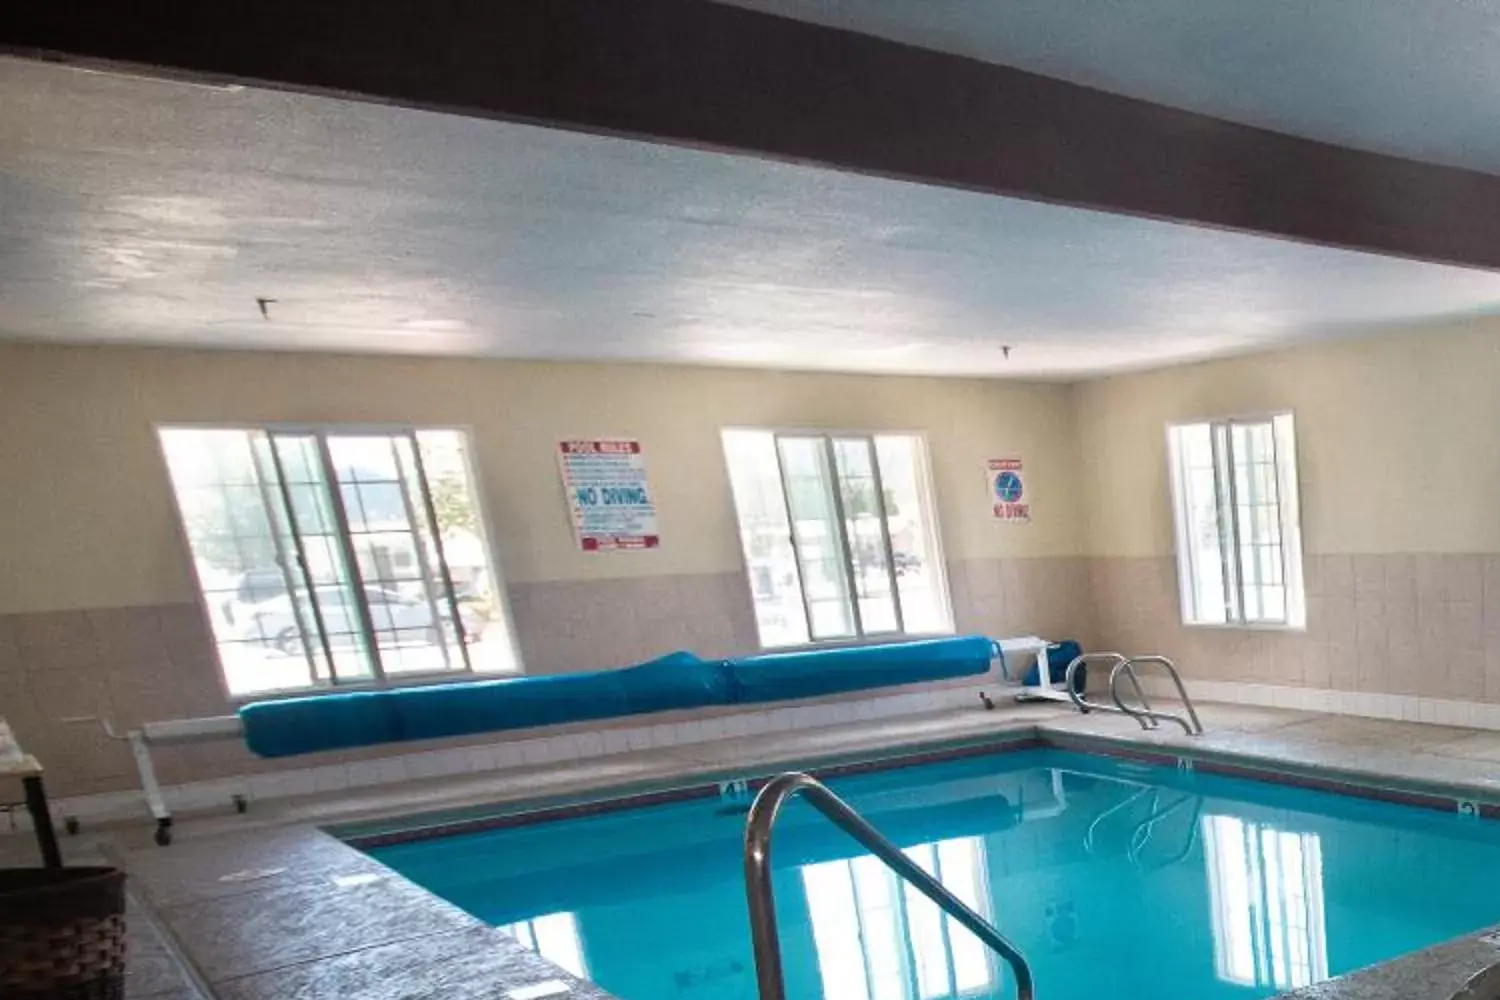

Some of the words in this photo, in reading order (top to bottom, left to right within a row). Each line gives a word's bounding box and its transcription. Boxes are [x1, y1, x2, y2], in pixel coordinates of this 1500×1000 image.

[577, 486, 598, 505] NO
[602, 486, 649, 505] DIVING
[993, 503, 1005, 518] NO
[1006, 503, 1030, 519] DIVING
